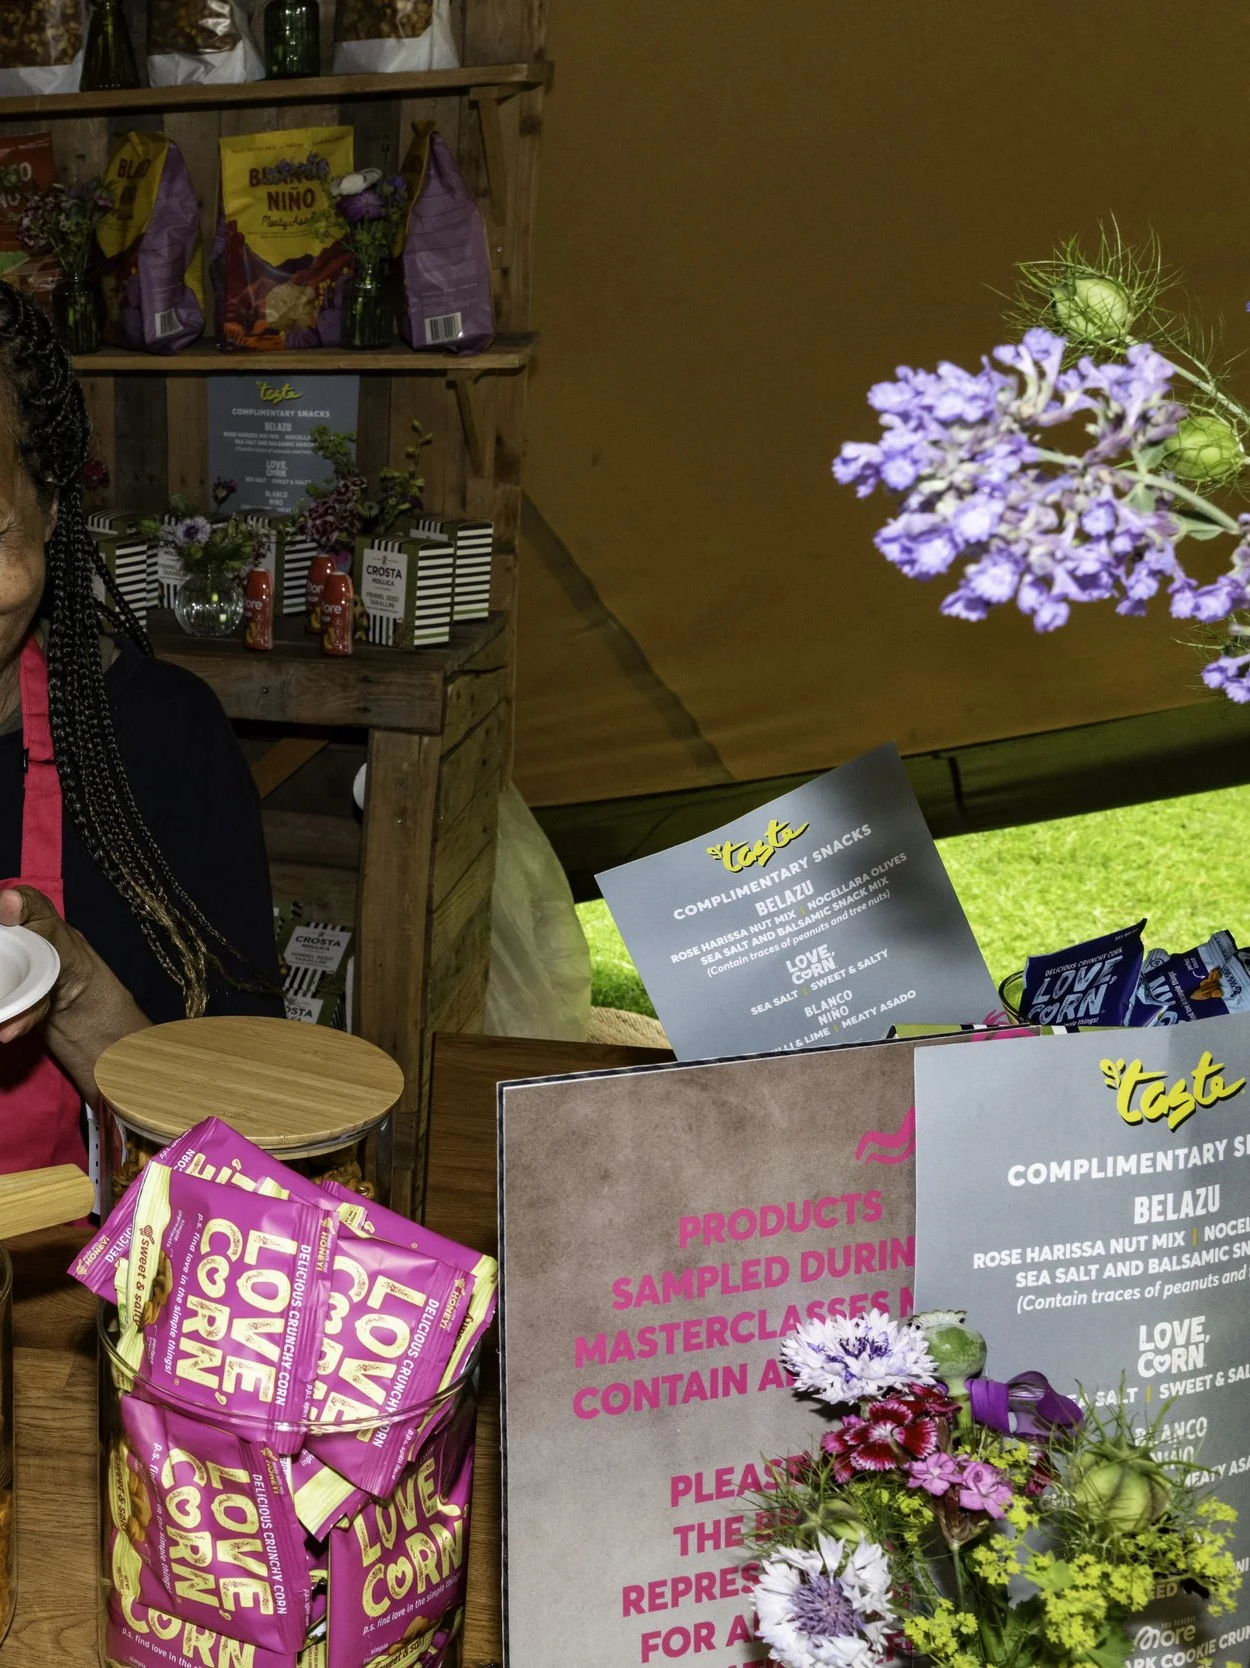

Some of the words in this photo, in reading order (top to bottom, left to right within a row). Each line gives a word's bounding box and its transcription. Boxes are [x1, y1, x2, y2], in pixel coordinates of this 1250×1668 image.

[266, 186, 315, 212] NIÑO
[232, 408, 295, 418] COMPLIMENTARY
[297, 410, 331, 419] SNACKS
[366, 565, 403, 580] CROSTA
[372, 578, 395, 587] MOLLICA
[673, 858, 809, 921] COMPLIMENTARY
[811, 823, 873, 864] SNACKS
[670, 943, 702, 965] ROSE
[700, 927, 750, 953] HARISSA
[749, 918, 774, 935] NUT
[774, 909, 798, 926] MIX
[806, 872, 872, 911] NOCELLARA
[870, 852, 909, 878] OLIVES
[754, 879, 815, 917] BELAZU
[296, 935, 342, 948] CROSTA
[700, 951, 724, 967] SEA
[723, 941, 750, 959] SALT
[751, 930, 778, 949] AND
[777, 906, 833, 938] BALSAMIC
[832, 887, 868, 913] SNACK
[867, 876, 891, 894] MIX
[707, 955, 750, 979] (Contain
[749, 942, 781, 963] traces
[780, 937, 794, 951] of
[792, 918, 831, 947] peanuts
[830, 908, 850, 929] and
[848, 904, 868, 922] tree
[867, 888, 891, 909] nuts)
[786, 943, 837, 974] LOVE,
[750, 1001, 773, 1017] SEA
[772, 988, 800, 1006] SALT
[810, 967, 848, 992] SWEET
[848, 964, 858, 976] &
[857, 948, 890, 971] SALTY
[803, 988, 854, 1018] BLANCO
[795, 1038, 805, 1048] &
[804, 1027, 832, 1045] LIME
[841, 1008, 878, 1029] MEATY
[879, 989, 918, 1013] ASADO
[817, 1003, 851, 1027] NIÑO
[1027, 984, 1108, 1026] CORN
[174, 1148, 197, 1173] CORN
[1008, 1138, 1229, 1188] COMPLIMENTARY
[195, 1212, 204, 1231] p.s.
[679, 1189, 884, 1249] PRODUCTS
[1133, 1184, 1221, 1226] BELAZU
[137, 1236, 150, 1280] sweet
[183, 1251, 194, 1275] love
[190, 1231, 201, 1254] find
[316, 1231, 329, 1273] HONEY!
[973, 1248, 1022, 1270] ROSE
[1026, 1240, 1106, 1264] HARISSA
[1109, 1236, 1149, 1255] NUT
[1152, 1230, 1186, 1250] MIX
[135, 1280, 146, 1292] &
[180, 1274, 190, 1286] in
[292, 1243, 311, 1308] DELICIOUS
[611, 1255, 790, 1311] SAMPLED
[800, 1235, 915, 1284] DURIN
[1016, 1270, 1052, 1288] SEA
[1054, 1264, 1100, 1284] SALT
[1102, 1259, 1145, 1280] AND
[1148, 1245, 1230, 1275] BALSAMIC
[132, 1291, 143, 1330] salty
[176, 1286, 186, 1305] the
[176, 1218, 243, 1392] CORN
[1016, 1292, 1089, 1315] (Contain
[1090, 1285, 1141, 1306] traces
[1144, 1280, 1162, 1299] of
[1163, 1273, 1220, 1299] peanuts
[1222, 1265, 1247, 1284] and
[170, 1303, 182, 1339] simple
[215, 1229, 299, 1405] LOVE,
[407, 1298, 440, 1360] DELICIOUS
[574, 1289, 890, 1369] MASTERCLASSES
[1139, 1316, 1211, 1351] LOVE,
[164, 1338, 177, 1375] things!
[282, 1309, 300, 1372] CRUNCHY
[275, 1373, 291, 1407] CORN
[386, 1358, 415, 1415] CRUNCHY
[572, 1363, 749, 1420] CONTAIN
[1095, 1387, 1139, 1408] SALT
[1159, 1375, 1213, 1399] SWEET
[1214, 1370, 1226, 1387] &
[150, 1442, 163, 1464] p.s.
[157, 1527, 167, 1561] simple
[161, 1447, 221, 1608] CORN
[253, 1473, 272, 1531] DELICIOUS
[264, 1530, 283, 1587] CRUNCHY
[274, 1586, 287, 1615] CORN
[673, 1514, 745, 1557] THE
[362, 1519, 463, 1618] CORN
[362, 1622, 376, 1636] p.s.
[377, 1614, 392, 1630] find
[391, 1608, 407, 1622] love
[407, 1602, 415, 1614] in
[414, 1596, 427, 1610] the
[425, 1585, 446, 1603] simple
[122, 1626, 134, 1641] p.s.
[135, 1631, 151, 1650] find
[151, 1642, 168, 1660] love
[169, 1648, 178, 1661] in
[178, 1653, 192, 1668] the
[370, 1641, 390, 1655] simple
[640, 1620, 717, 1664] FOR
[1160, 1638, 1217, 1668] COOKIE
